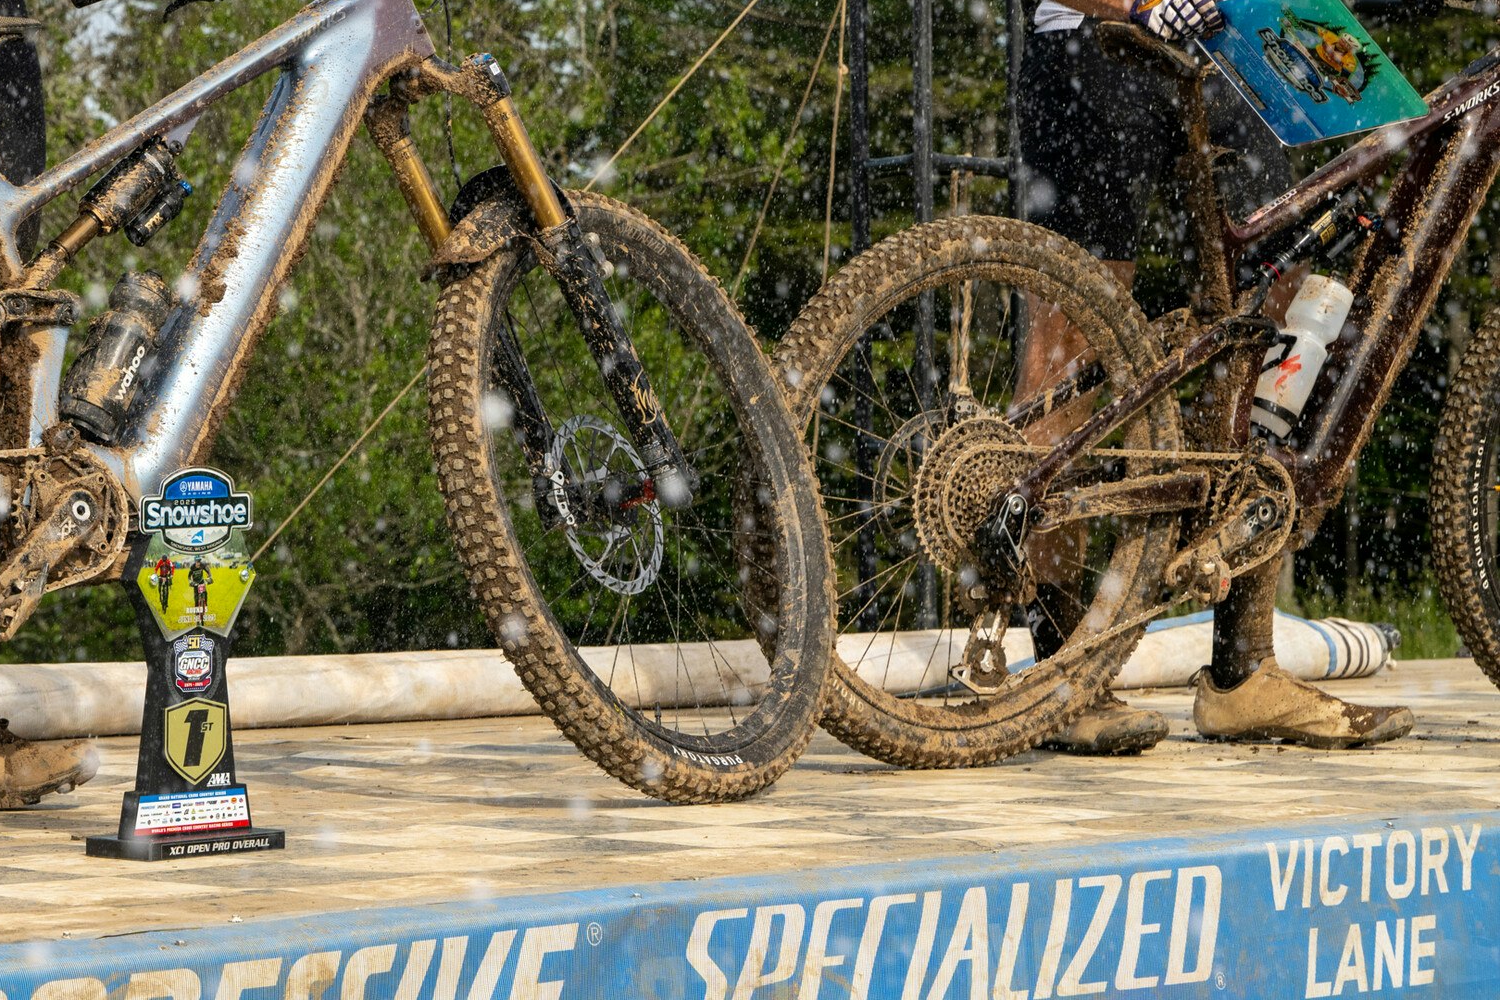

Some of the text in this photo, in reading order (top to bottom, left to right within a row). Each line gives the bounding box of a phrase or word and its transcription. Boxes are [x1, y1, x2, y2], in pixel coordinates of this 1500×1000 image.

[1443, 79, 1500, 124] S-WORKS
[115, 345, 145, 401] wahoo
[187, 481, 213, 491] YAMAHA
[146, 500, 247, 527] Snowshoe
[1472, 436, 1489, 590] GROUND CONTROL
[188, 638, 201, 649] 50
[180, 657, 209, 670] GNCC
[183, 709, 214, 767] 1ST
[672, 744, 743, 765] PURGATORY
[206, 772, 231, 786] AMA
[187, 843, 210, 854] OPEN
[212, 841, 231, 852] PRO
[232, 837, 270, 850] OVERALL
[1266, 822, 1483, 912] VICTORY
[684, 864, 1222, 1000] SPECIALIZED
[1305, 913, 1438, 1000] LANE
